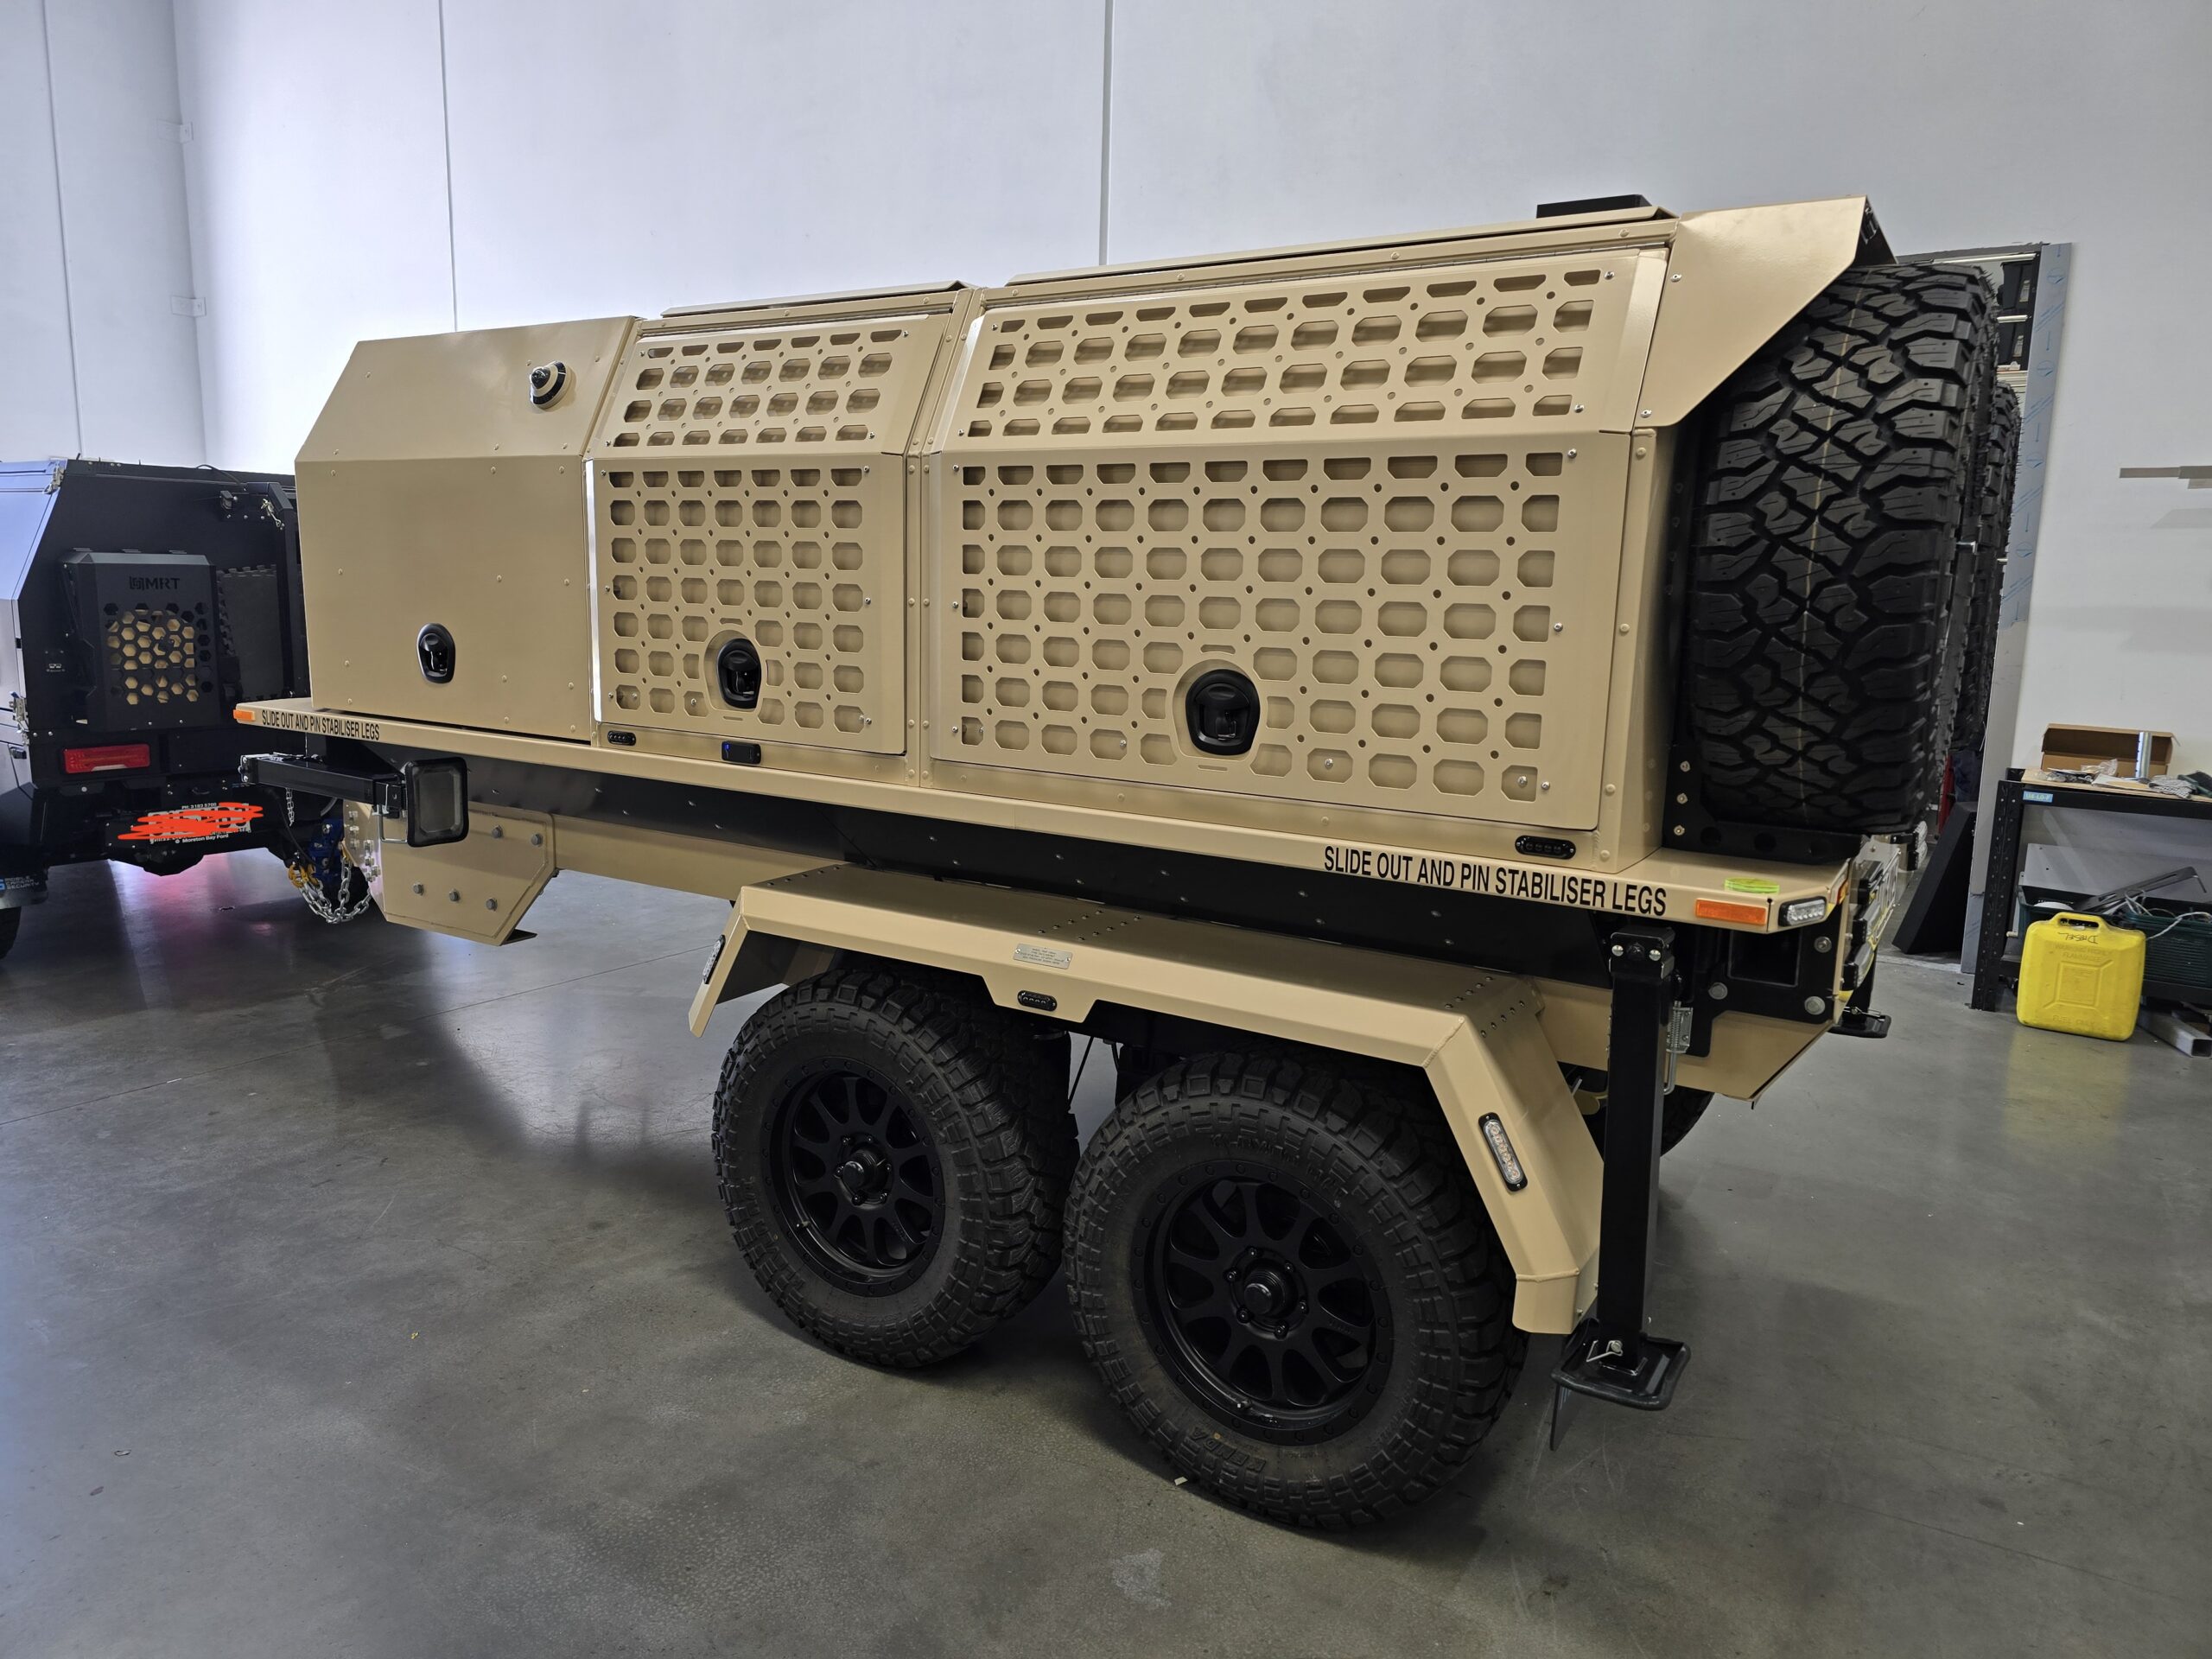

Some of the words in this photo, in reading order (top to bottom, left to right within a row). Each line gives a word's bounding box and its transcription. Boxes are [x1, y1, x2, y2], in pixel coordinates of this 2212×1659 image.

[262, 709, 280, 727] SLIDE
[280, 713, 294, 729] OUT
[295, 715, 308, 730] AND
[310, 716, 321, 732] PIN
[321, 717, 359, 737] STABILISER
[361, 723, 379, 741] LEGS
[1324, 846, 1372, 876] SLIDE
[1376, 852, 1414, 881] OUT
[1416, 857, 1455, 887] AND
[1460, 862, 1490, 893] PIN
[1495, 867, 1606, 908] STABILISER
[1612, 882, 1667, 917] LEGS
[1190, 1427, 1267, 1474] KENDA
